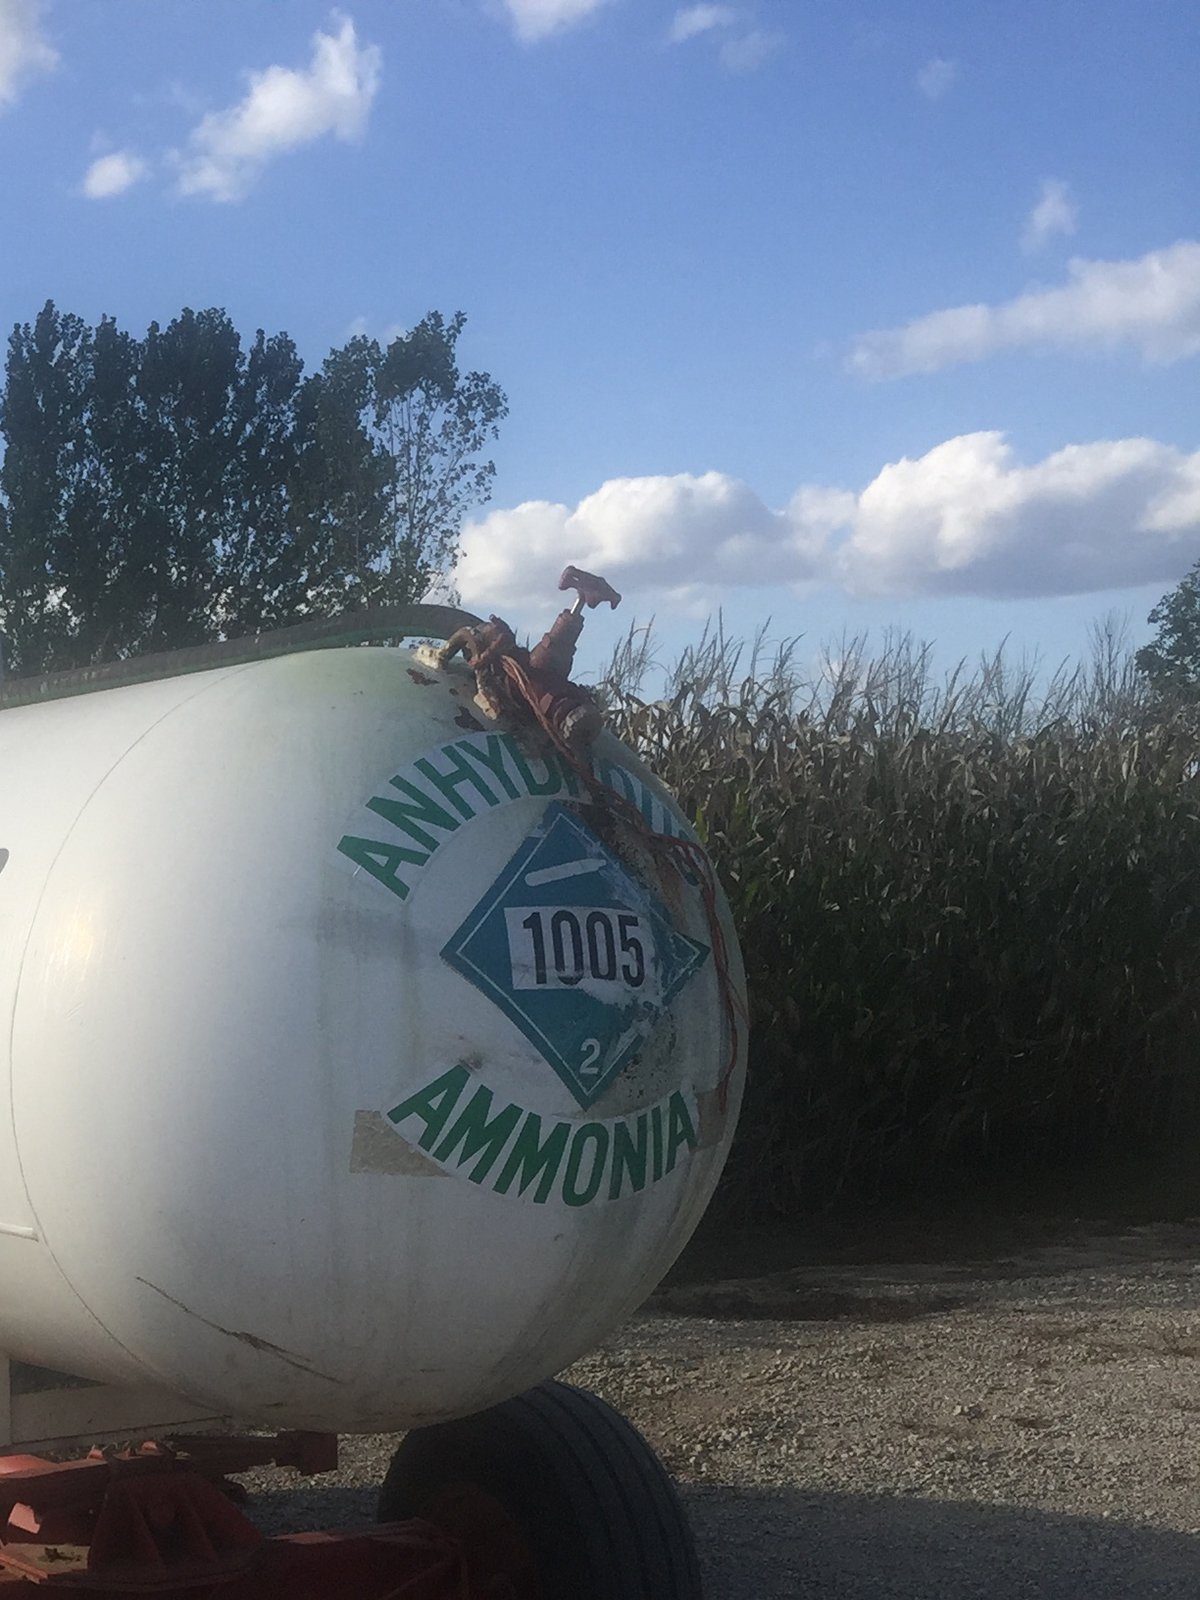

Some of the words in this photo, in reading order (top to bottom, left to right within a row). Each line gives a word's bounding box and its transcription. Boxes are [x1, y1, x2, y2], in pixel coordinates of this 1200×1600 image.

[522, 909, 646, 988] 1005
[579, 1038, 601, 1075] 2
[386, 1063, 698, 1208] AMMONIA
